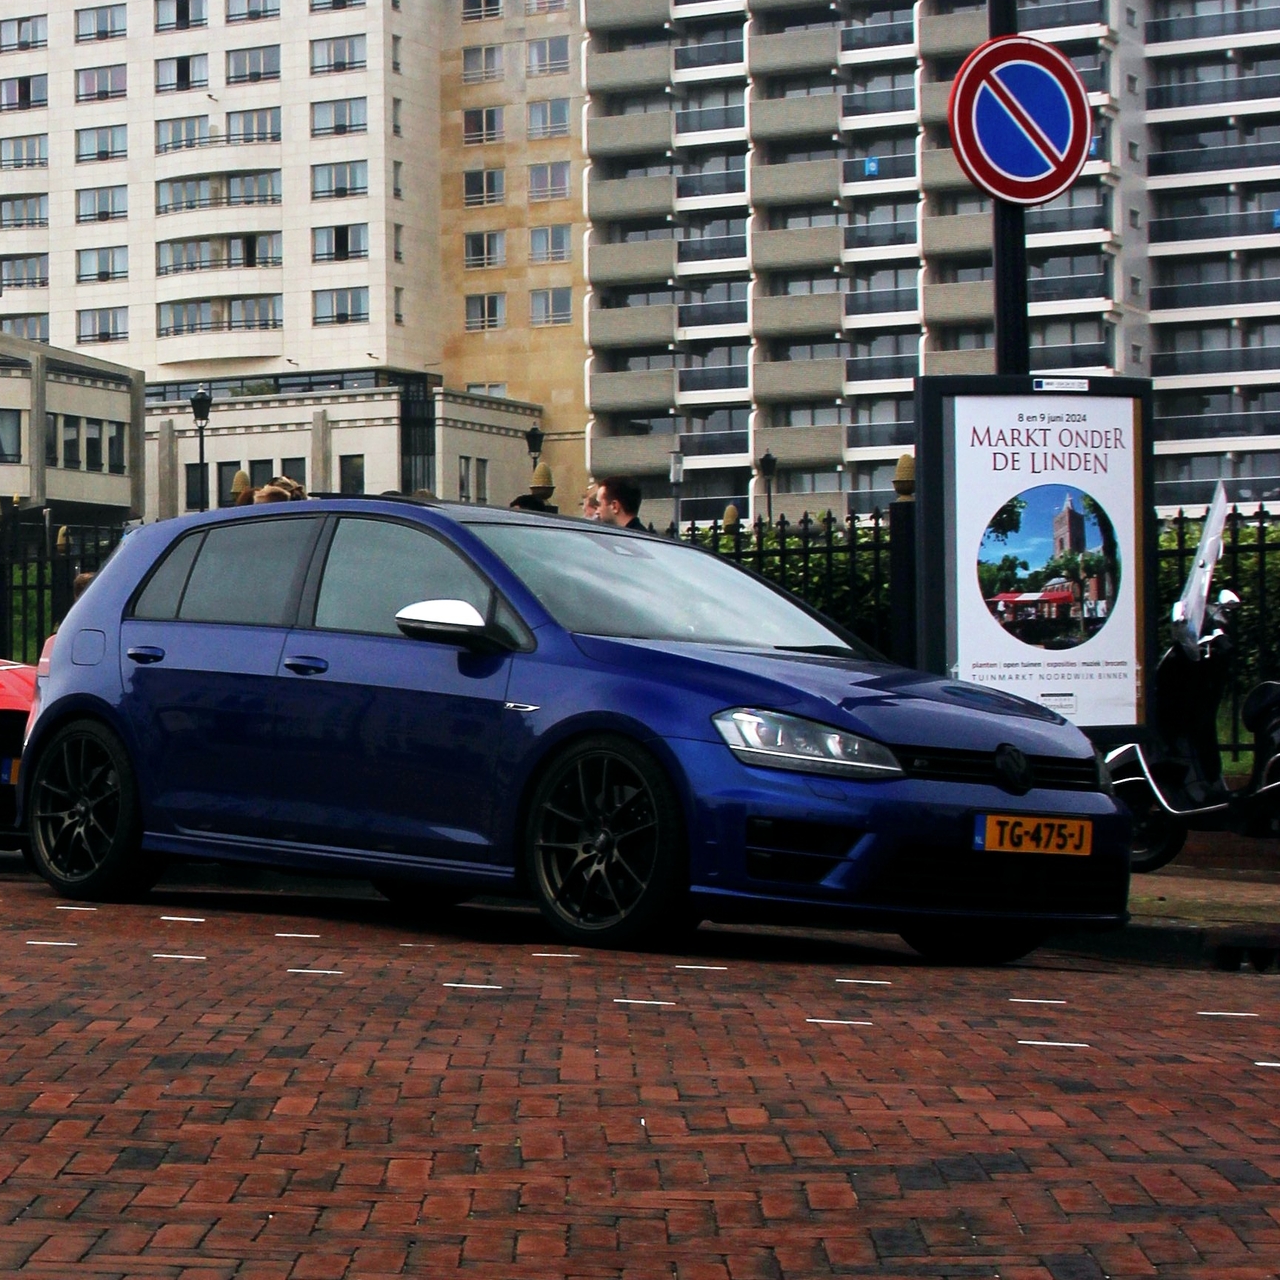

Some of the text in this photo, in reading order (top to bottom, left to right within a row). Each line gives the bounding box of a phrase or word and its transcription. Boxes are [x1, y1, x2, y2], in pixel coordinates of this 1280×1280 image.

[1017, 413, 1024, 422] 8
[1039, 413, 1046, 422] 9
[1047, 413, 1064, 424] juni
[1065, 413, 1087, 422] 2024
[970, 426, 1126, 449] MARKT ONDER
[992, 452, 1108, 474] DE LINDEN
[972, 673, 1034, 681] TUINMARKT
[1098, 672, 1128, 680] BINNEN
[996, 820, 1085, 850] TG-475-J
